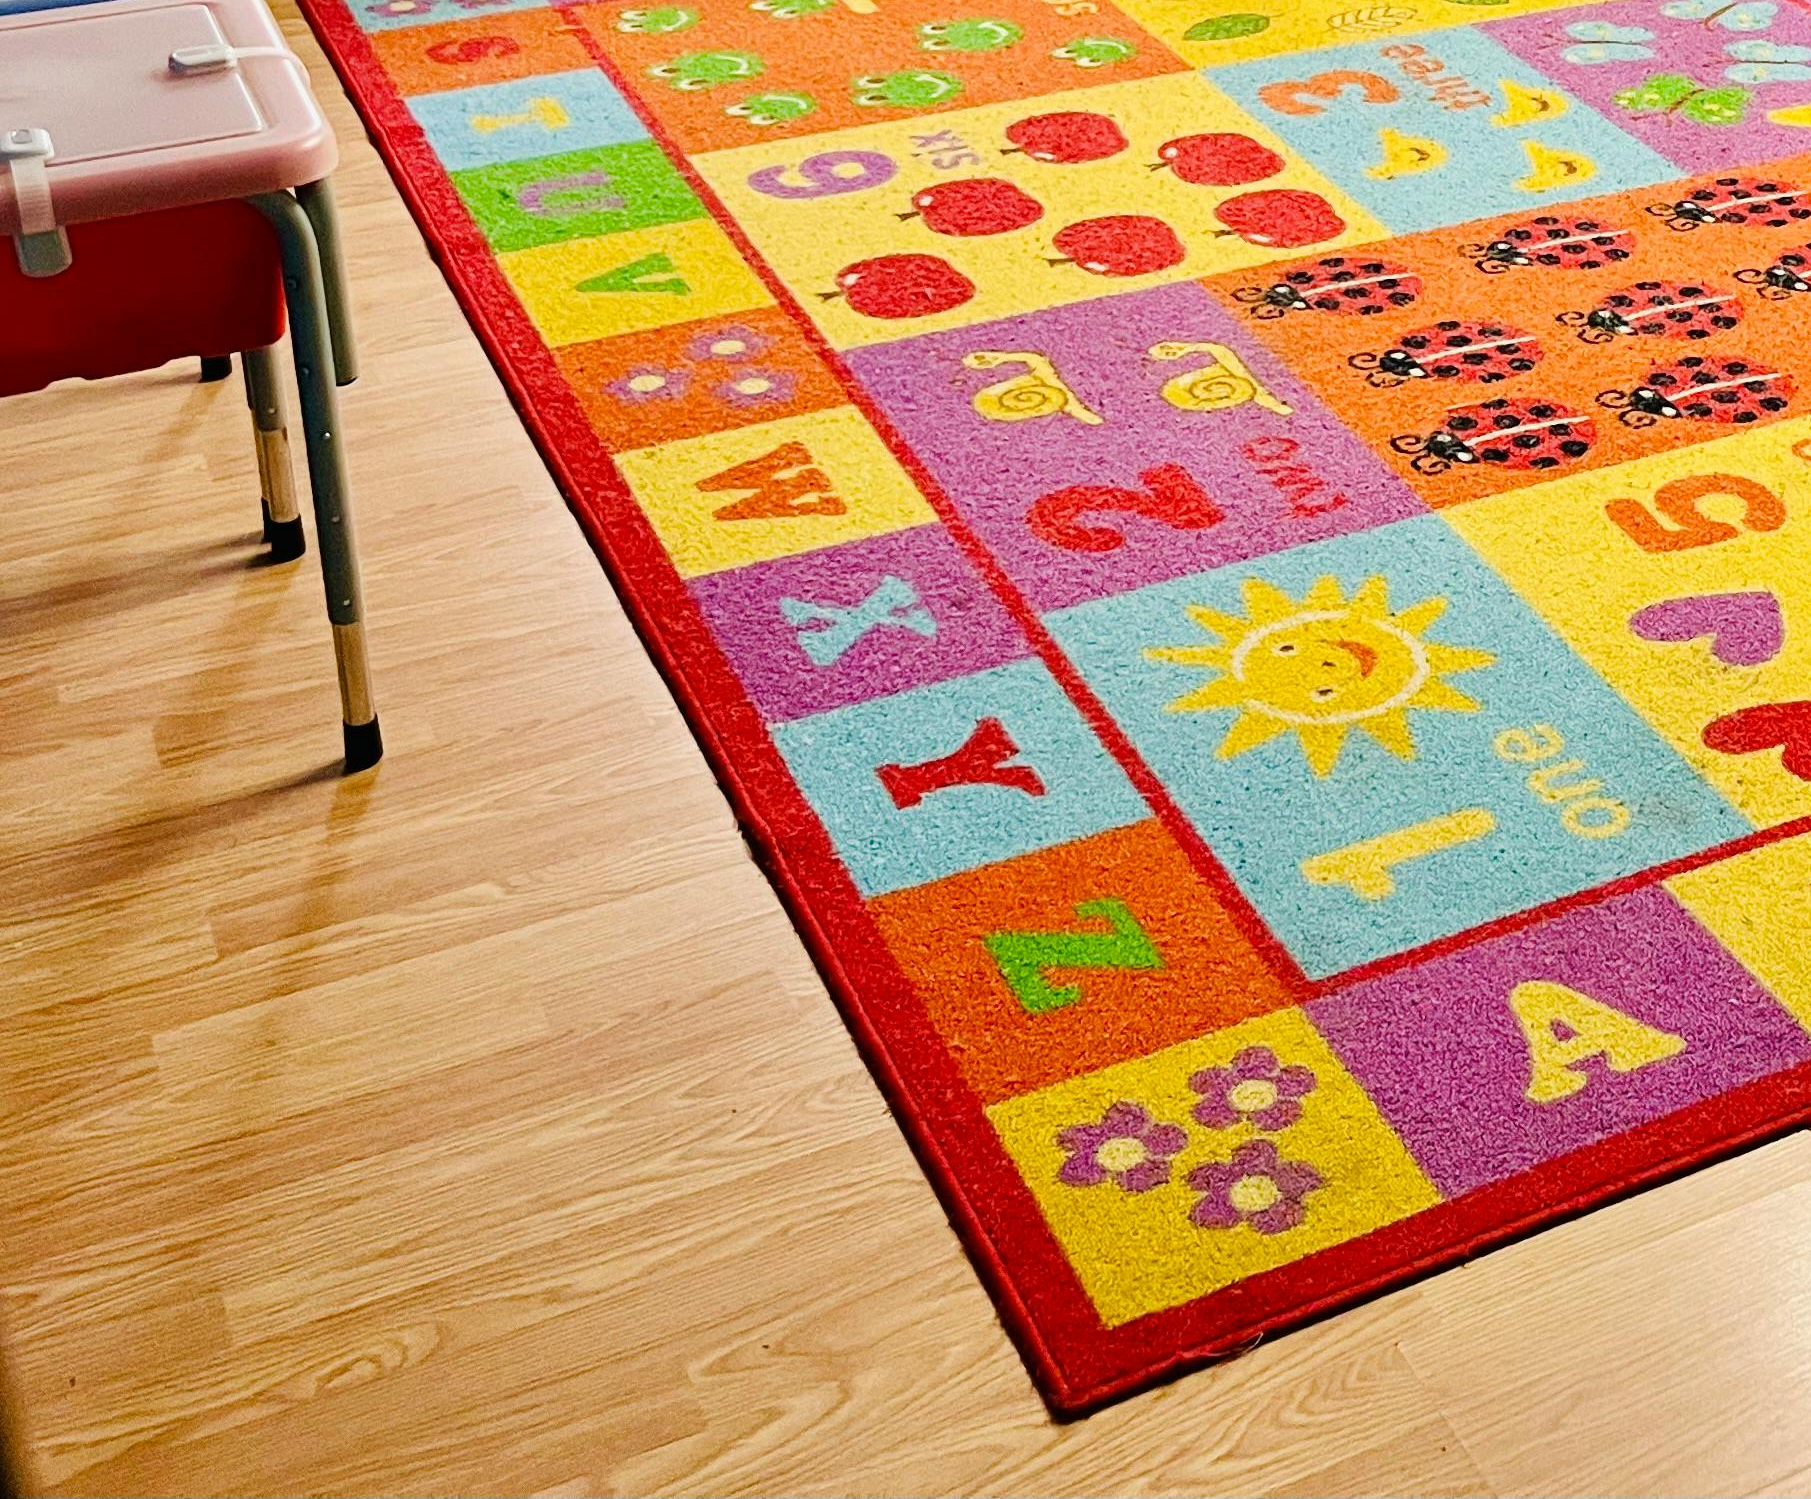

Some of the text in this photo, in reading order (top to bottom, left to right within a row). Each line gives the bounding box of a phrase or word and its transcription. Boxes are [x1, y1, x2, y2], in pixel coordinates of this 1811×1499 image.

[425, 36, 520, 65] S
[1379, 43, 1493, 111] three
[470, 95, 571, 131] T
[1257, 69, 1400, 116] 3
[908, 128, 980, 171] six
[517, 170, 626, 217] U
[574, 252, 692, 296] V
[695, 441, 847, 521] W
[1026, 461, 1225, 554] 2
[1241, 436, 1348, 519] two
[1603, 473, 1788, 553] 5
[780, 574, 937, 667] X
[874, 715, 1046, 810] Y
[1494, 722, 1631, 840] one
[1300, 808, 1497, 902] 1
[981, 896, 1166, 1014] Z
[1508, 979, 1686, 1104] A
